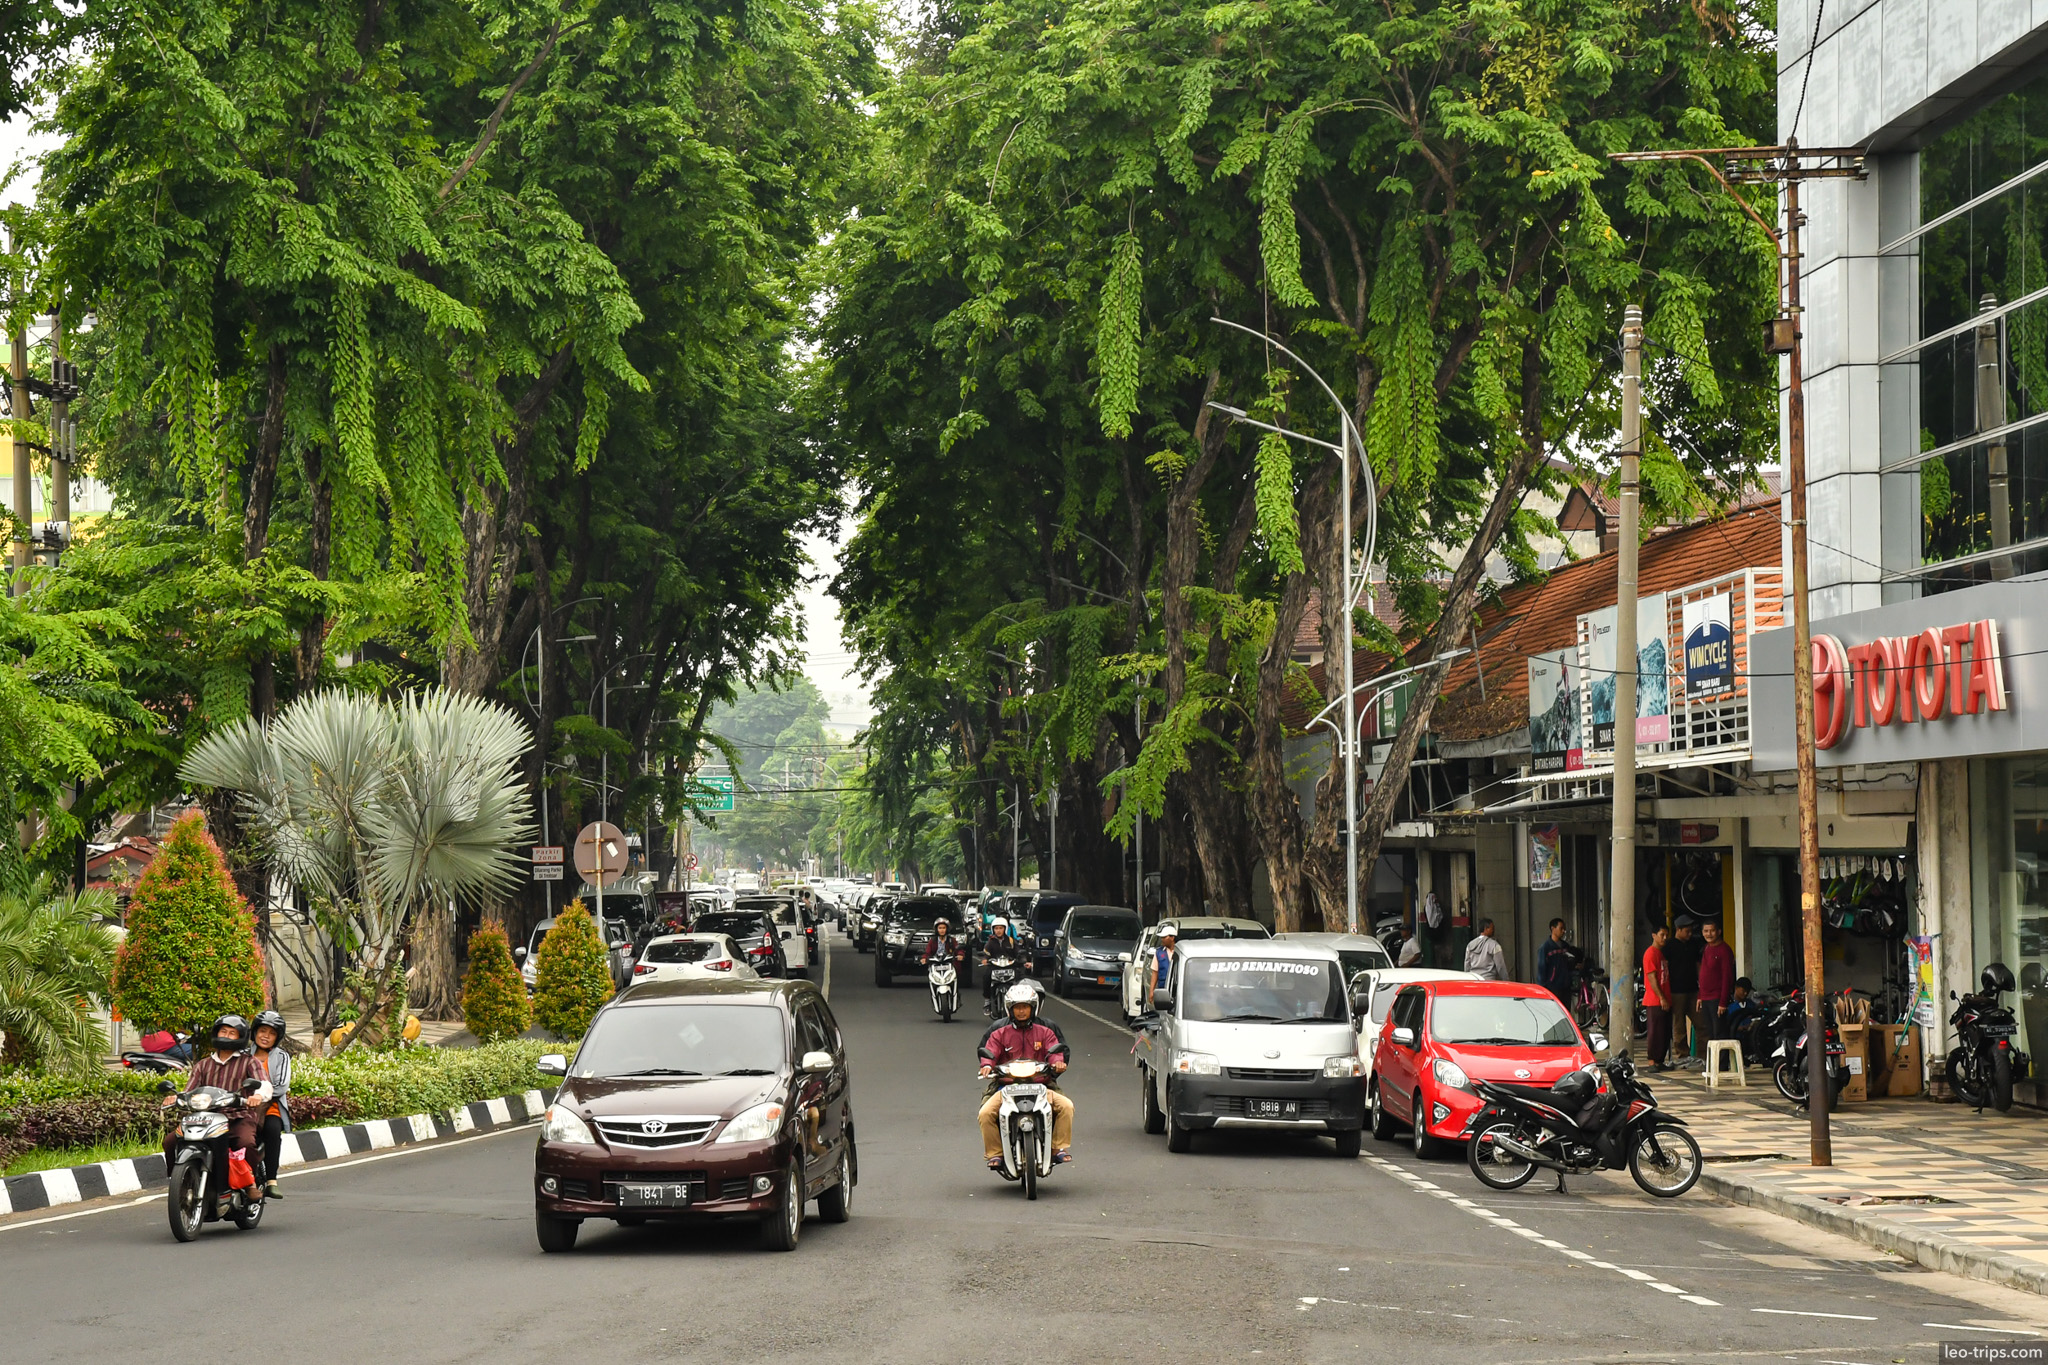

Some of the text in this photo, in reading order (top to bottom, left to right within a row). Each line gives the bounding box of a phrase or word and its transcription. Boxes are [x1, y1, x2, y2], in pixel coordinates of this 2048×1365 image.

[1689, 640, 1727, 670] WIMCYCLE
[1848, 619, 2004, 728] TOYOTA
[1599, 728, 1612, 743] SINAR
[1208, 961, 1319, 976] BEJO SENANTIOSO
[1249, 1100, 1296, 1113] L 9818 AN
[639, 1186, 663, 1200] 1841
